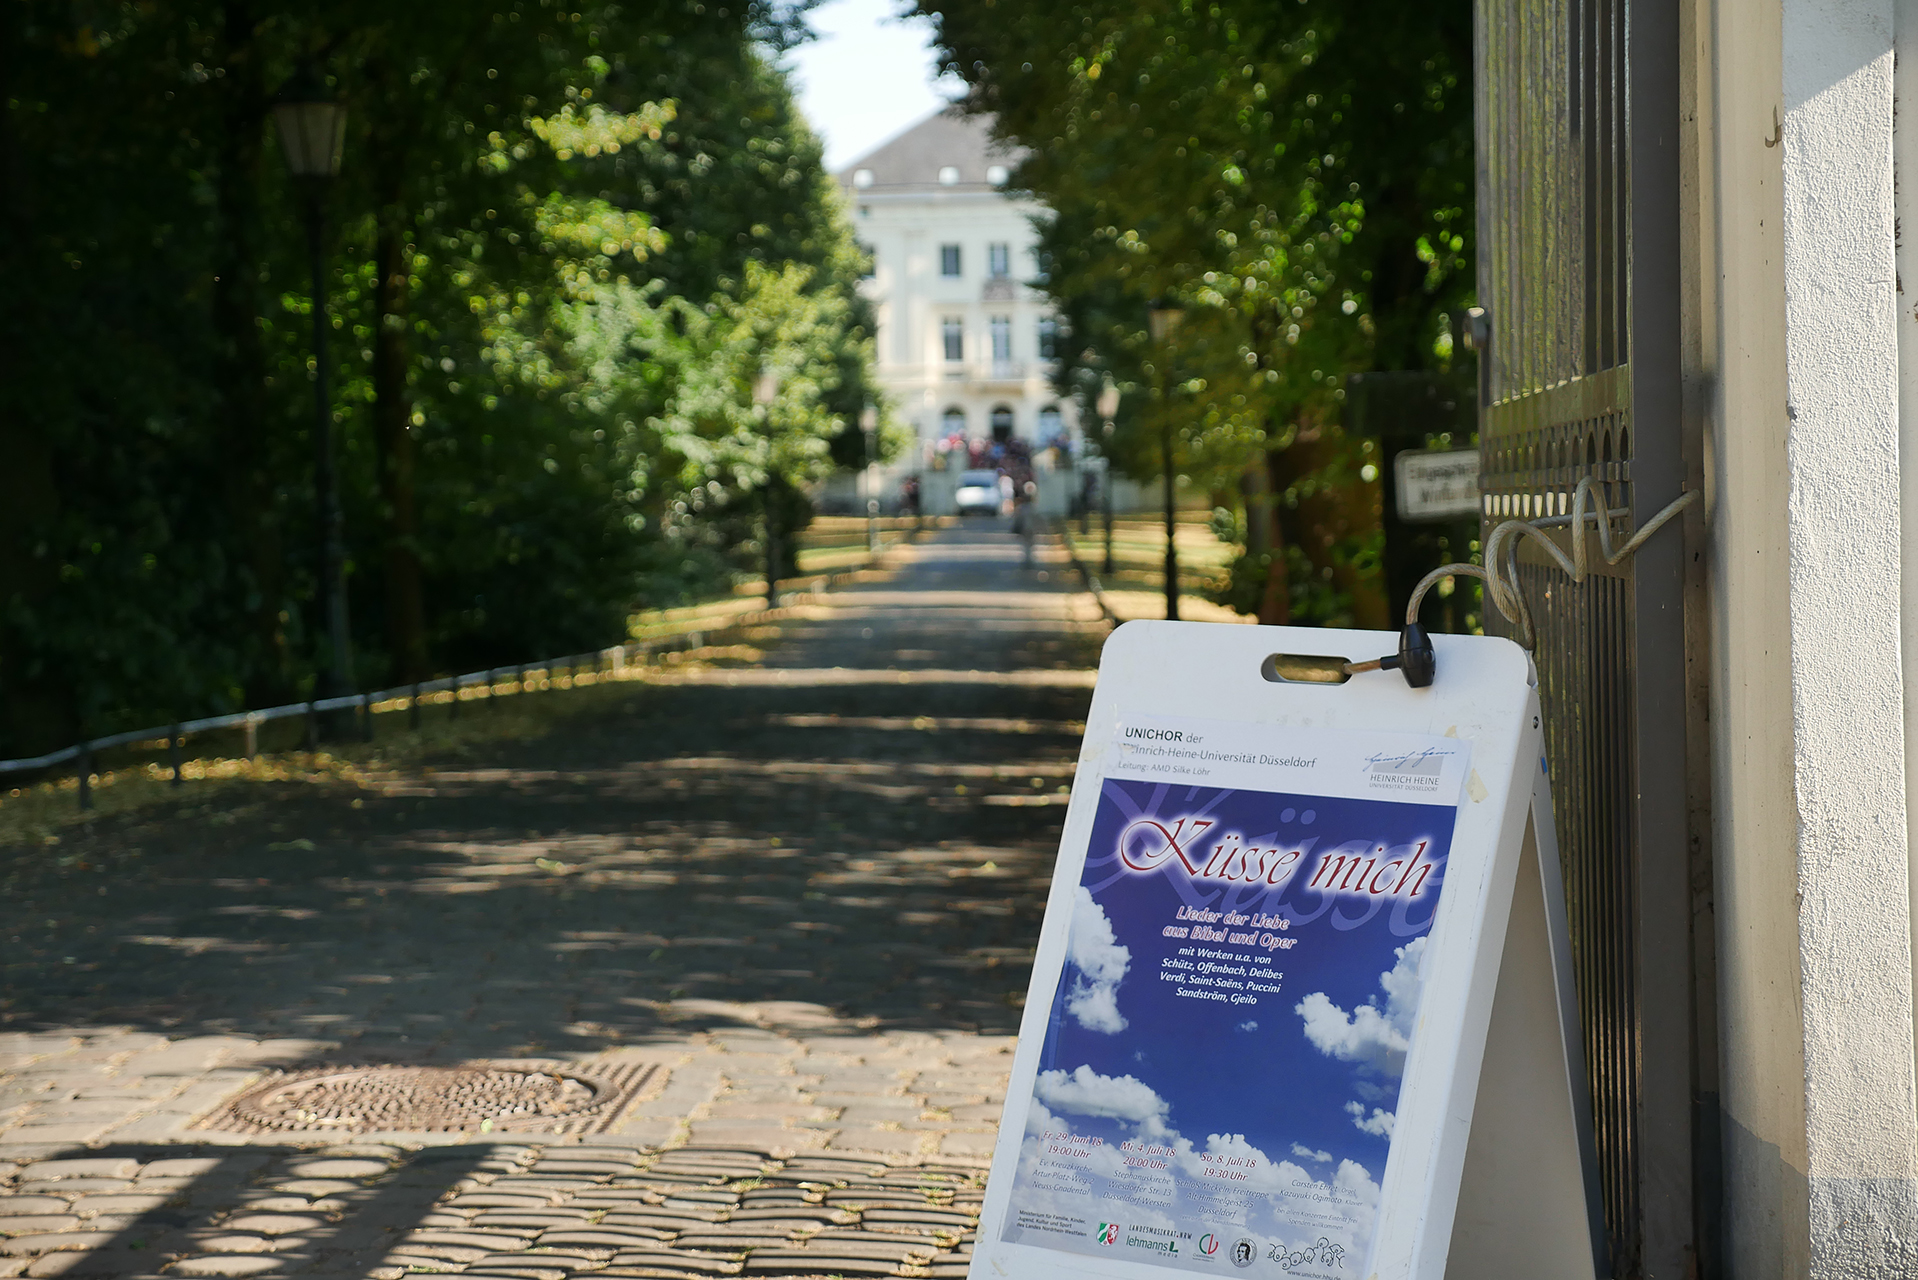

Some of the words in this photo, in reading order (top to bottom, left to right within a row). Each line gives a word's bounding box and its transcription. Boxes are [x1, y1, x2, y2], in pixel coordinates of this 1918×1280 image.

[1125, 727, 1183, 742] UNICHOR
[1186, 732, 1204, 743] der
[1259, 753, 1317, 768] Düsseldorf
[1118, 761, 1149, 772] Leitung:
[1151, 764, 1171, 772] AMD
[1173, 765, 1191, 774] Silke
[1193, 767, 1211, 776] Löhr
[1369, 782, 1404, 790] UNIVERSITÄT
[1405, 784, 1438, 792] DÜSSELDORF
[1370, 774, 1412, 784] HEINRICH
[1413, 777, 1439, 786] HEINE
[1120, 817, 1300, 885] Küsse
[1310, 840, 1432, 898] mich
[1176, 905, 1222, 923] Lieder
[1223, 910, 1249, 926] der
[1250, 913, 1290, 930] Liebe
[1162, 925, 1189, 938] aus
[1190, 925, 1229, 943] Bibel
[1229, 931, 1259, 946] und
[1260, 932, 1297, 952] Oper
[1178, 946, 1195, 957] mit
[1197, 948, 1234, 961] Werken
[1235, 953, 1252, 962] u.a.
[1254, 955, 1272, 965] von
[1161, 957, 1195, 972] Schütz,
[1197, 961, 1247, 977] Offenbach,
[1249, 967, 1284, 980] Delibes
[1159, 971, 1187, 984] Verdi,
[1188, 974, 1244, 990] Saint-Saëns,
[1246, 981, 1282, 993] Puccini
[1175, 987, 1228, 1003] Sandström,
[1230, 993, 1258, 1005] Gjeilo
[1055, 1132, 1068, 1142] 29.
[1069, 1134, 1091, 1144] Juni
[1091, 1137, 1104, 1147] 18
[1048, 1145, 1072, 1156] 19:00
[1073, 1148, 1091, 1158] Uhr
[1137, 1144, 1144, 1153] 4.
[1145, 1145, 1164, 1156] Juli
[1165, 1147, 1177, 1157] 18
[1039, 1158, 1049, 1167] Ev.
[1050, 1160, 1092, 1173] Kreuzkirche
[1122, 1156, 1149, 1168] 20:00
[1150, 1160, 1168, 1170] Uhr
[1200, 1152, 1214, 1164] So,
[1216, 1154, 1224, 1164] 8.
[1225, 1156, 1243, 1167] Juli
[1245, 1158, 1257, 1169] 18
[1113, 1169, 1171, 1185] Stephanuskirche
[1203, 1167, 1229, 1179] 19:30
[1230, 1171, 1248, 1181] Uhr
[1108, 1180, 1147, 1194] Wiesdorfer
[1148, 1186, 1160, 1195] Str.
[1162, 1188, 1172, 1197] 13
[1291, 1179, 1318, 1190] Carsten
[1232, 1186, 1270, 1199] Freitreppe
[1279, 1189, 1312, 1200] Kazuyuki
[1312, 1193, 1342, 1204] Ogimoto
[1243, 1200, 1254, 1208] 25
[1019, 1210, 1044, 1218] Ministerium
[1300, 1211, 1328, 1219] Konzerten
[1126, 1235, 1168, 1252] lehmanns
